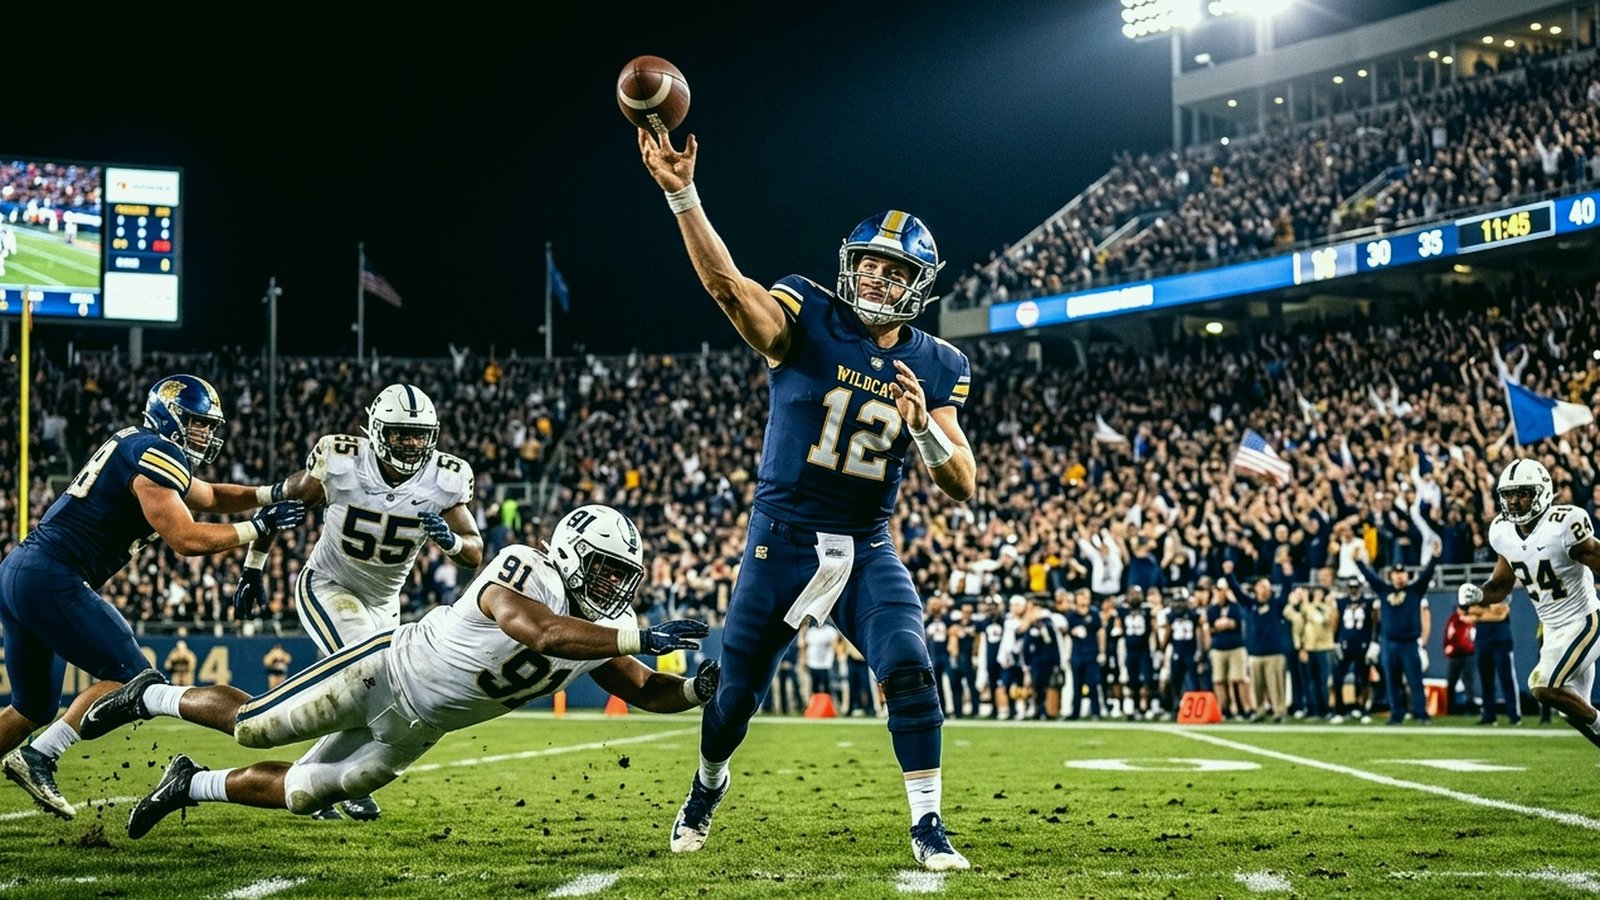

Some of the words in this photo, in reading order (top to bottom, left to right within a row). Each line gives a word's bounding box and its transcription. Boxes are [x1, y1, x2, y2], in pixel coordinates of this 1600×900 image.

[1480, 211, 1532, 243] 11:45
[1568, 196, 1596, 226] 40
[1366, 239, 1392, 268] 30
[1418, 229, 1444, 258] 35
[806, 386, 902, 482] 12
[341, 505, 422, 565] 55
[1570, 516, 1593, 541] 24
[498, 555, 534, 593] 91
[1511, 558, 1568, 603] 24
[477, 648, 574, 711] 91
[1183, 696, 1207, 719] 30
